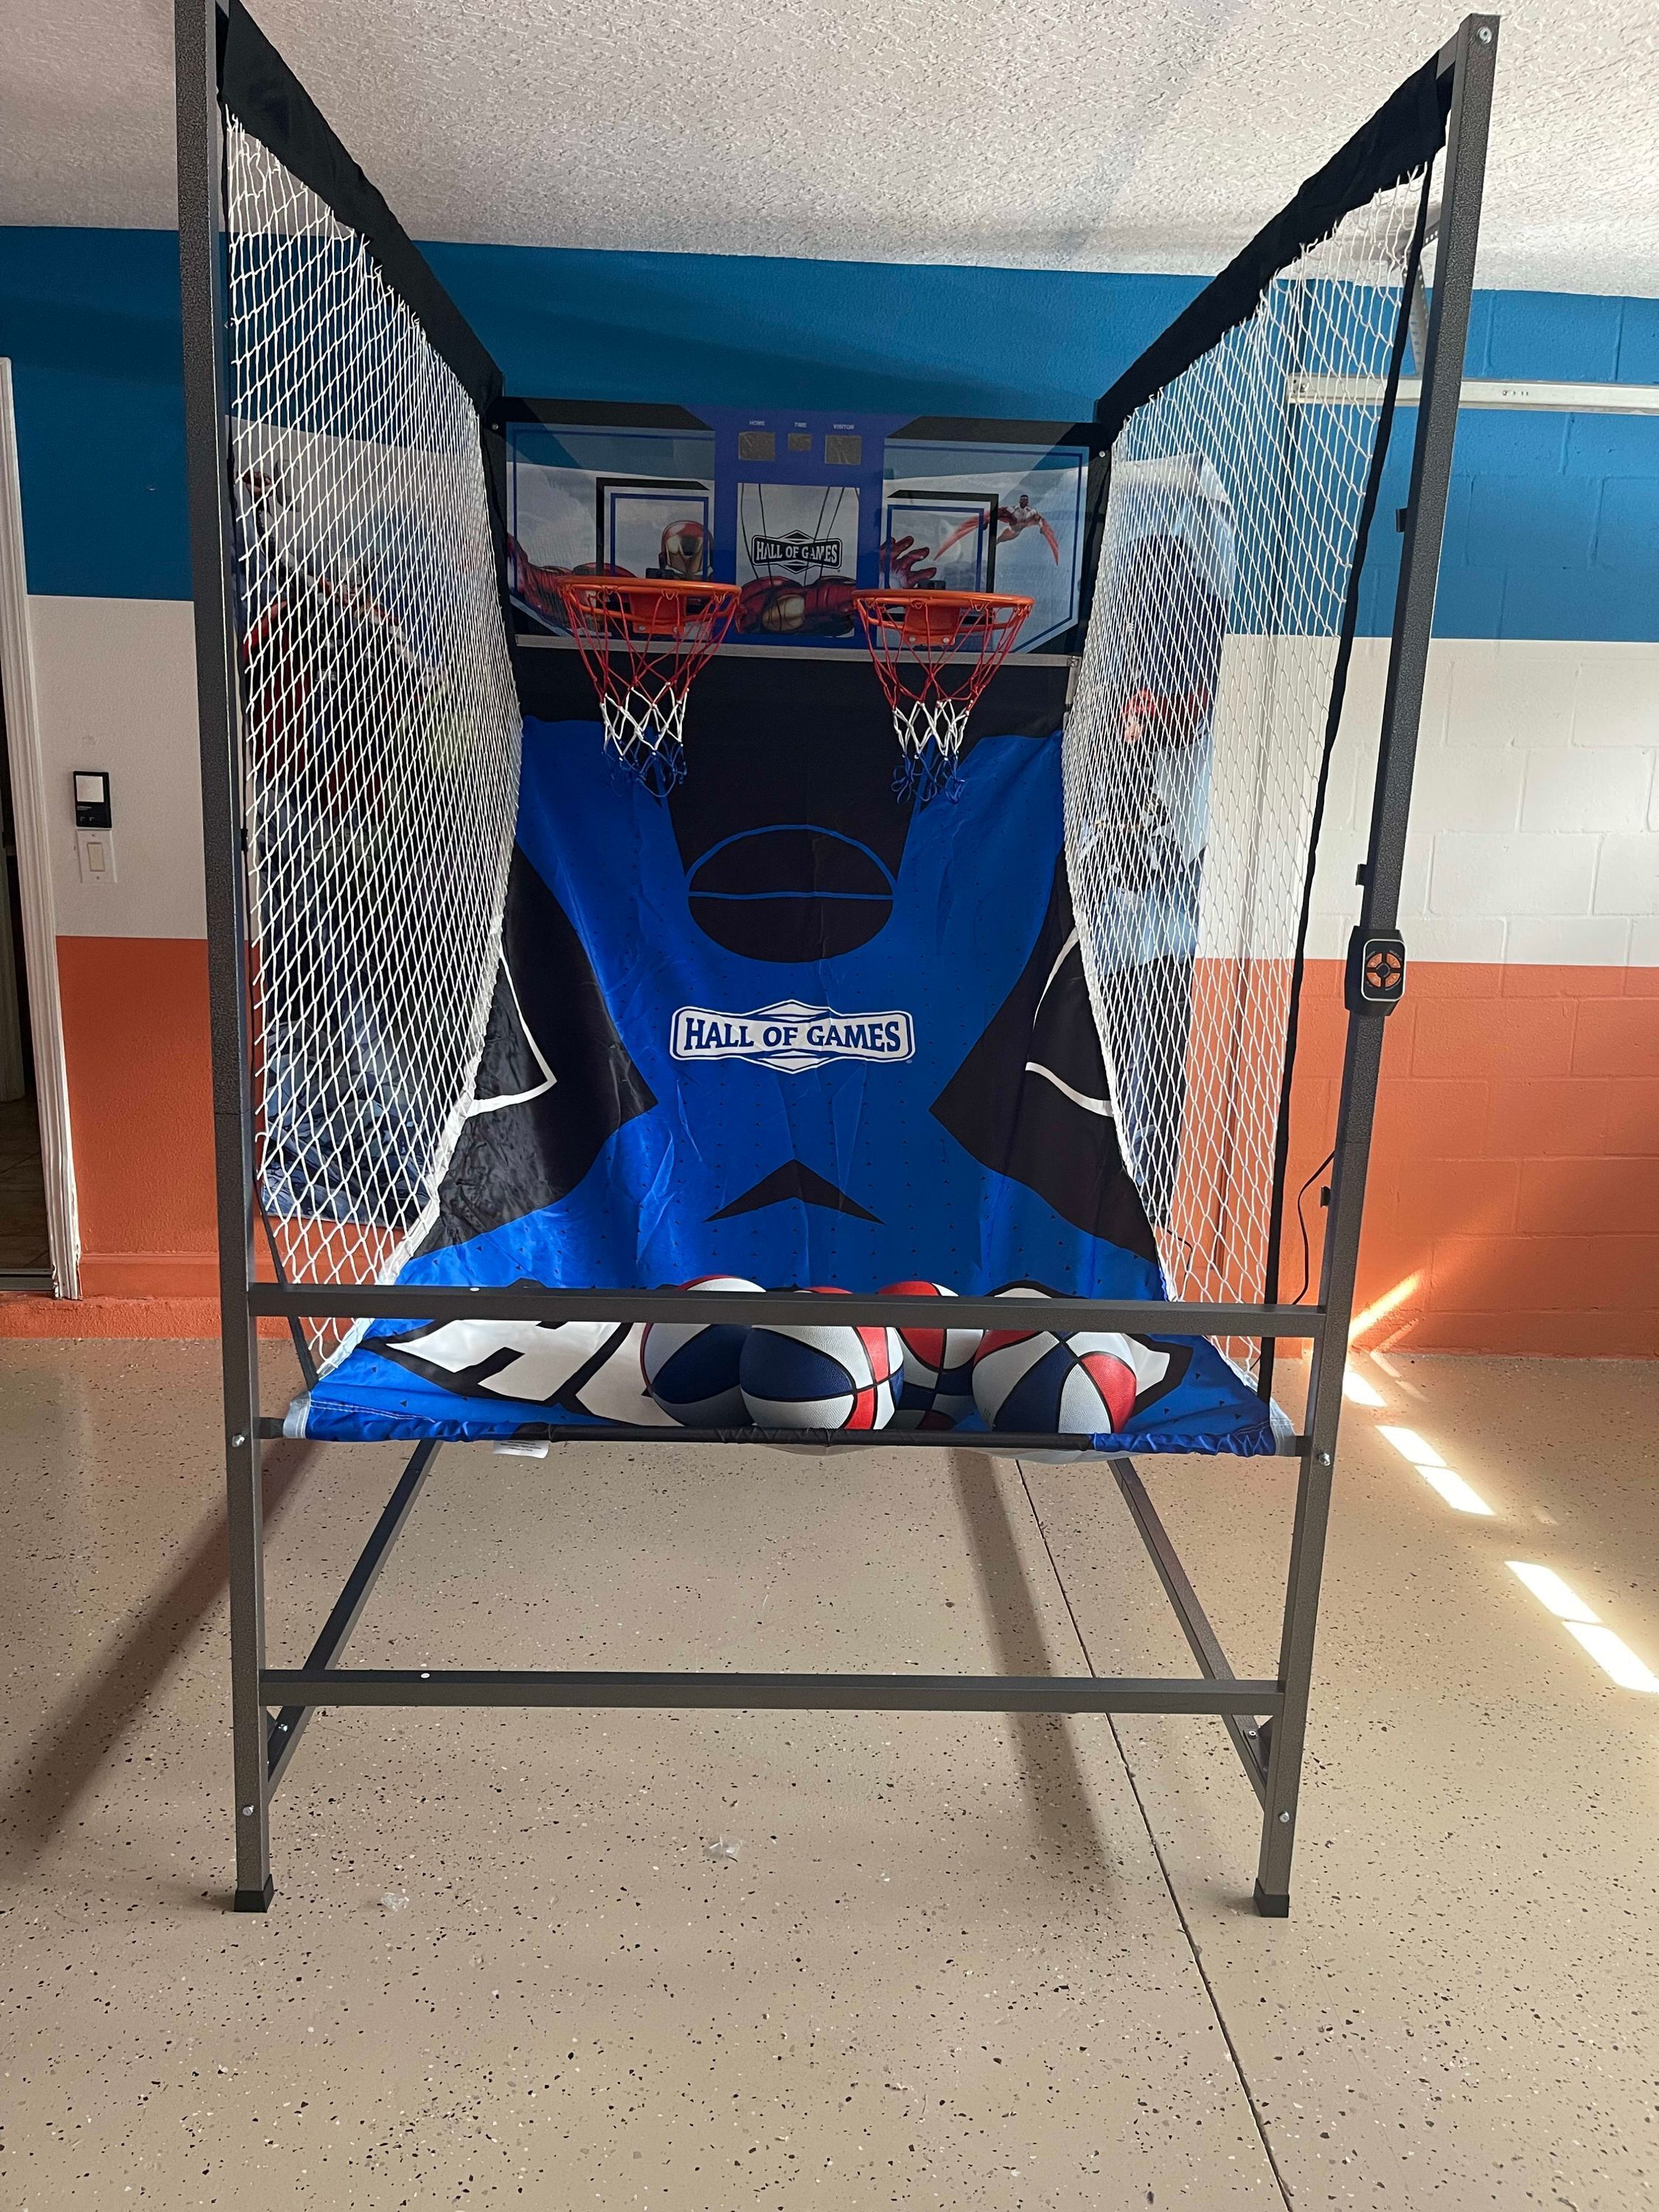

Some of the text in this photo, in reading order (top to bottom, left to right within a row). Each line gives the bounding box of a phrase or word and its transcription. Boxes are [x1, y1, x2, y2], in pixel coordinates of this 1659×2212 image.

[756, 540, 838, 563] HALL OF GAMES
[684, 1018, 901, 1052] HALL OF GAMES
